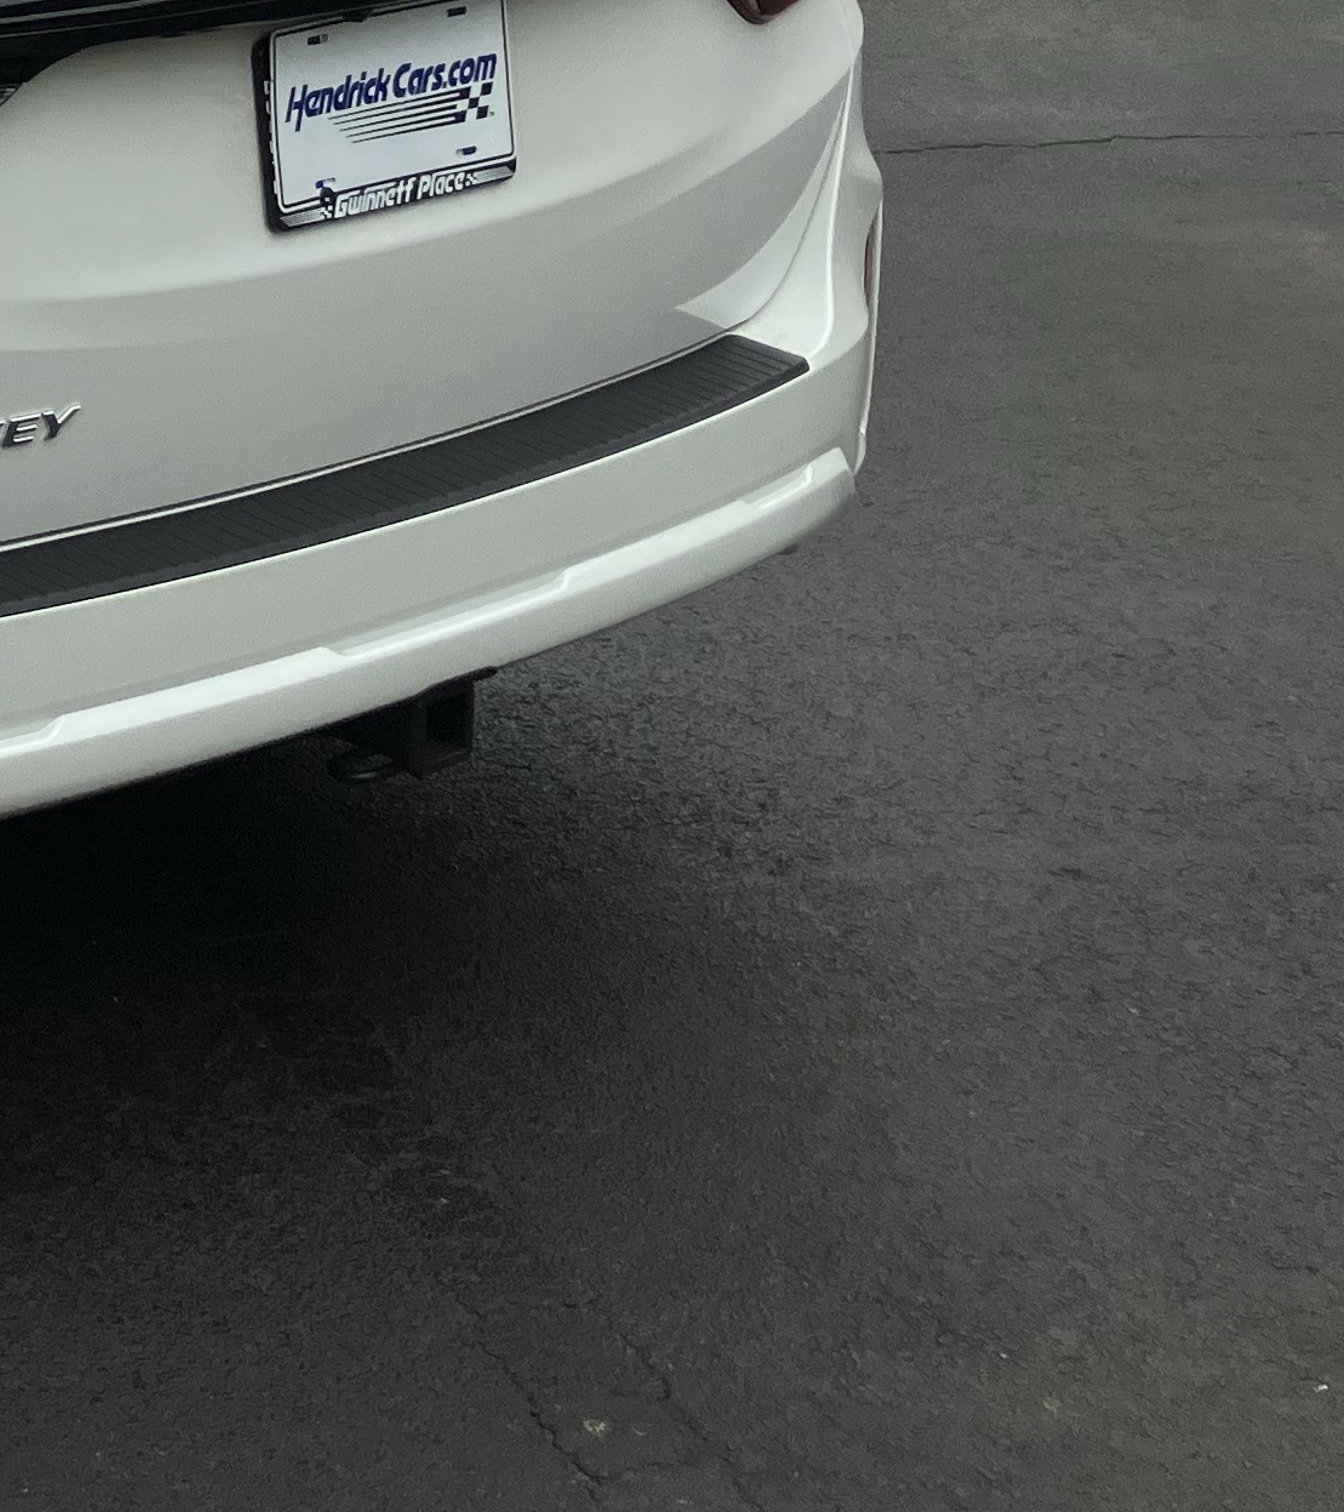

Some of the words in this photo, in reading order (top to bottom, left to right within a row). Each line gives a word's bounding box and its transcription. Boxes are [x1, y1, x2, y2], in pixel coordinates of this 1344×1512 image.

[285, 68, 391, 132] Hendrick
[393, 53, 498, 98] Cars.com
[334, 180, 416, 218] Gwinnett
[417, 172, 466, 199] Place
